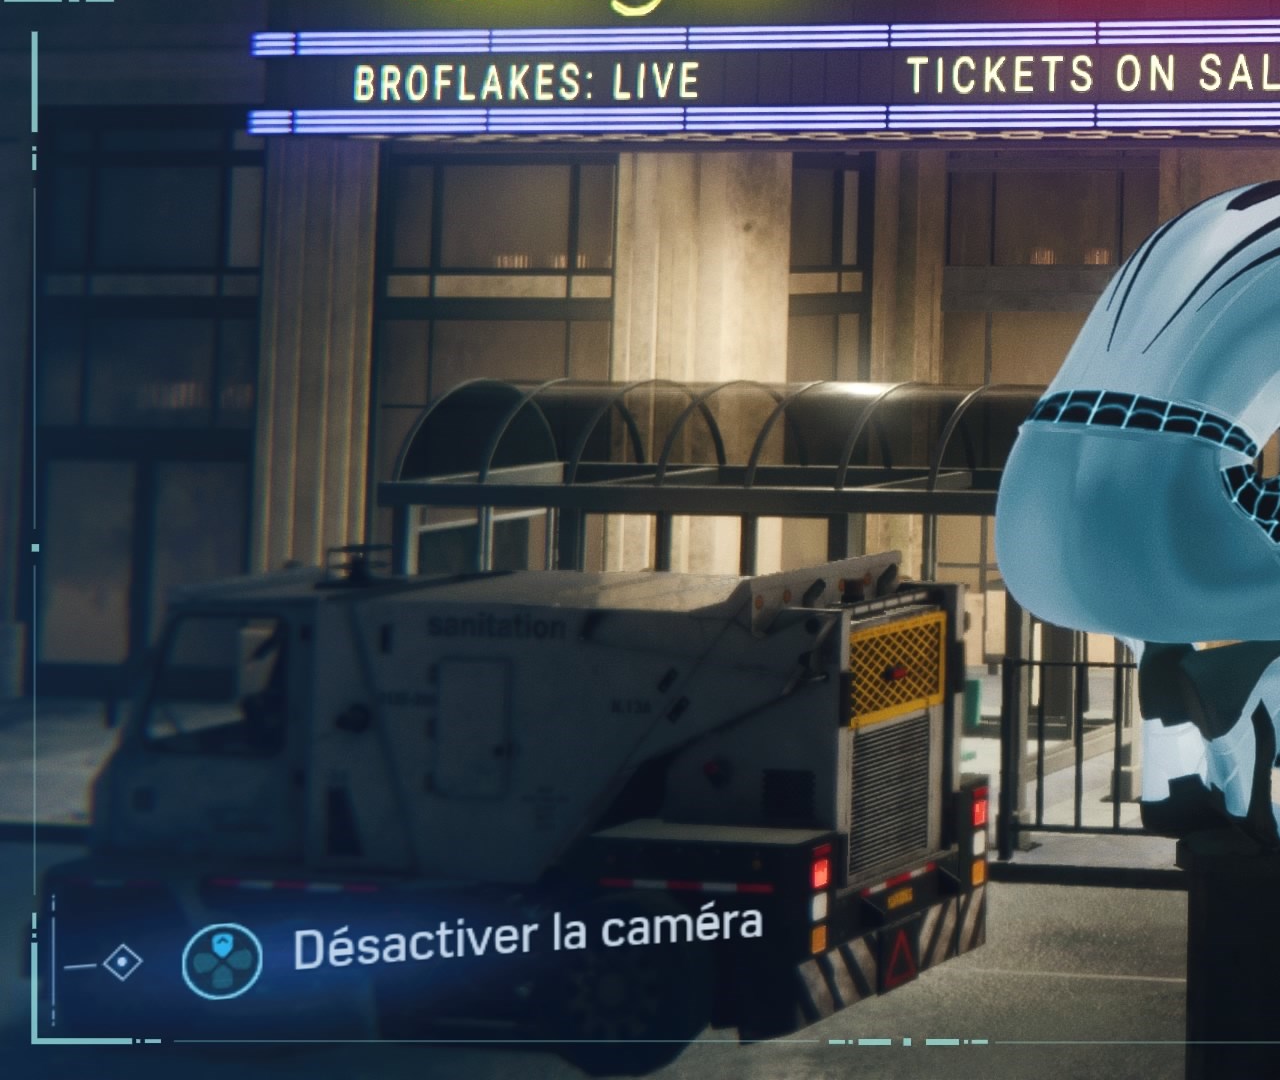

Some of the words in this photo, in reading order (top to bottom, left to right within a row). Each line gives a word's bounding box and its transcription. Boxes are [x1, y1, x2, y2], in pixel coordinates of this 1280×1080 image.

[353, 63, 594, 102] BROFLAKES:
[613, 61, 700, 100] LIVE
[907, 55, 1094, 95] TICKETS
[1116, 53, 1175, 92] ON
[427, 612, 566, 640] sanitation
